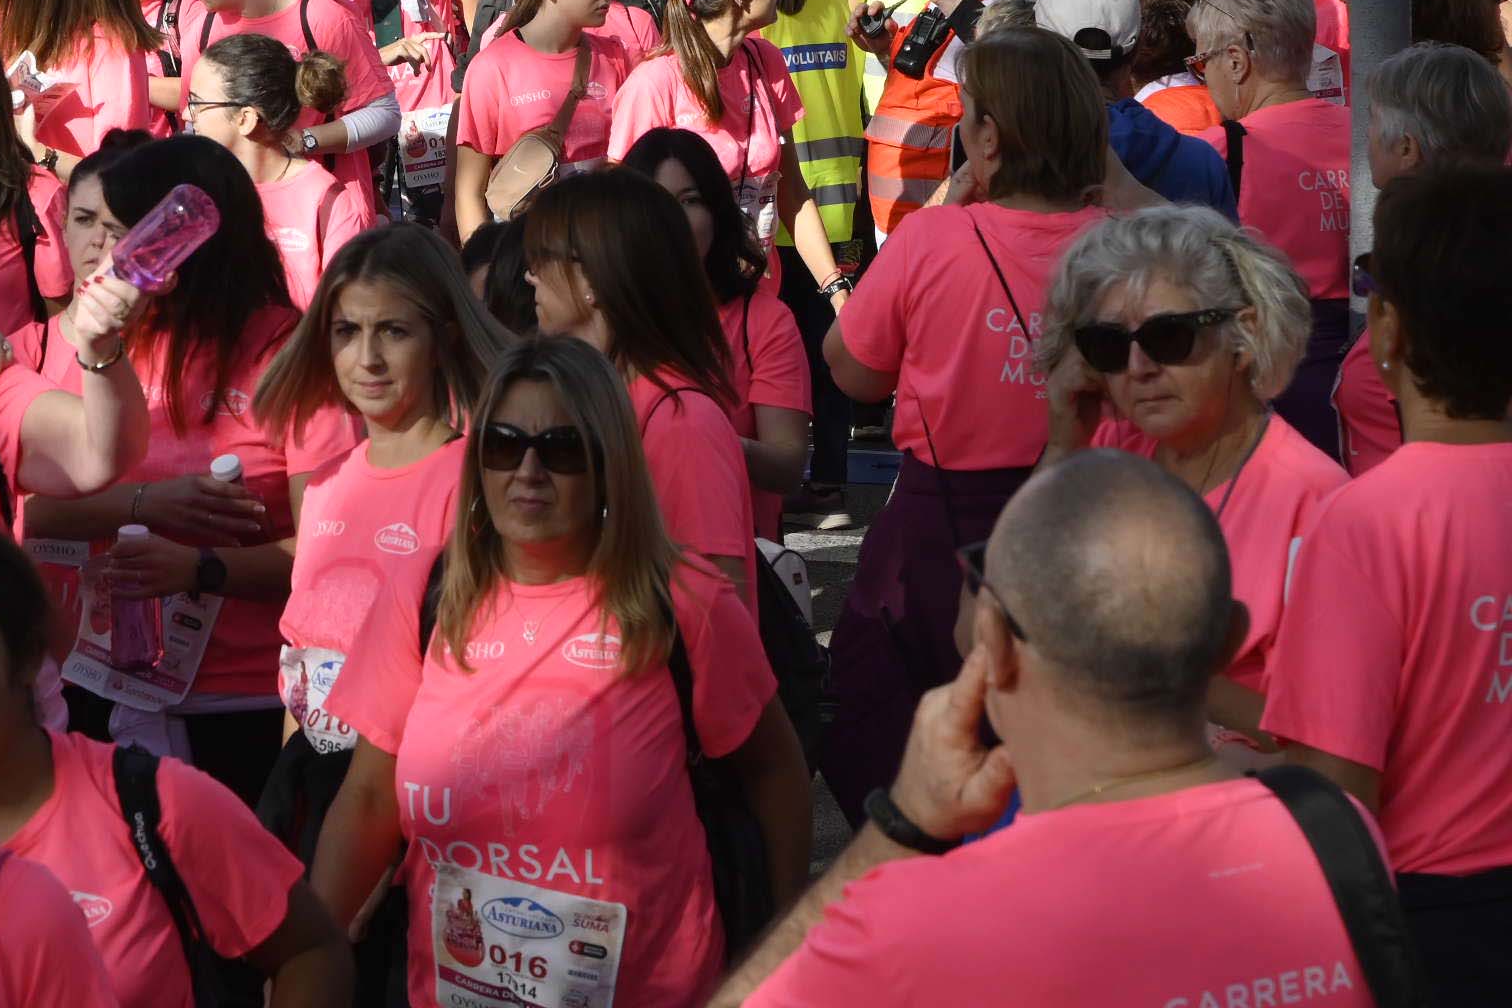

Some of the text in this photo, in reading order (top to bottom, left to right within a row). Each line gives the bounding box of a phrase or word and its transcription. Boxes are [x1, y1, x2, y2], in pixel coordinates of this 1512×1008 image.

[404, 782, 451, 826] TU
[419, 836, 604, 885] DORSAL
[488, 906, 557, 935] ASTURIANA
[571, 918, 610, 934] SUMA
[489, 944, 548, 980] 016
